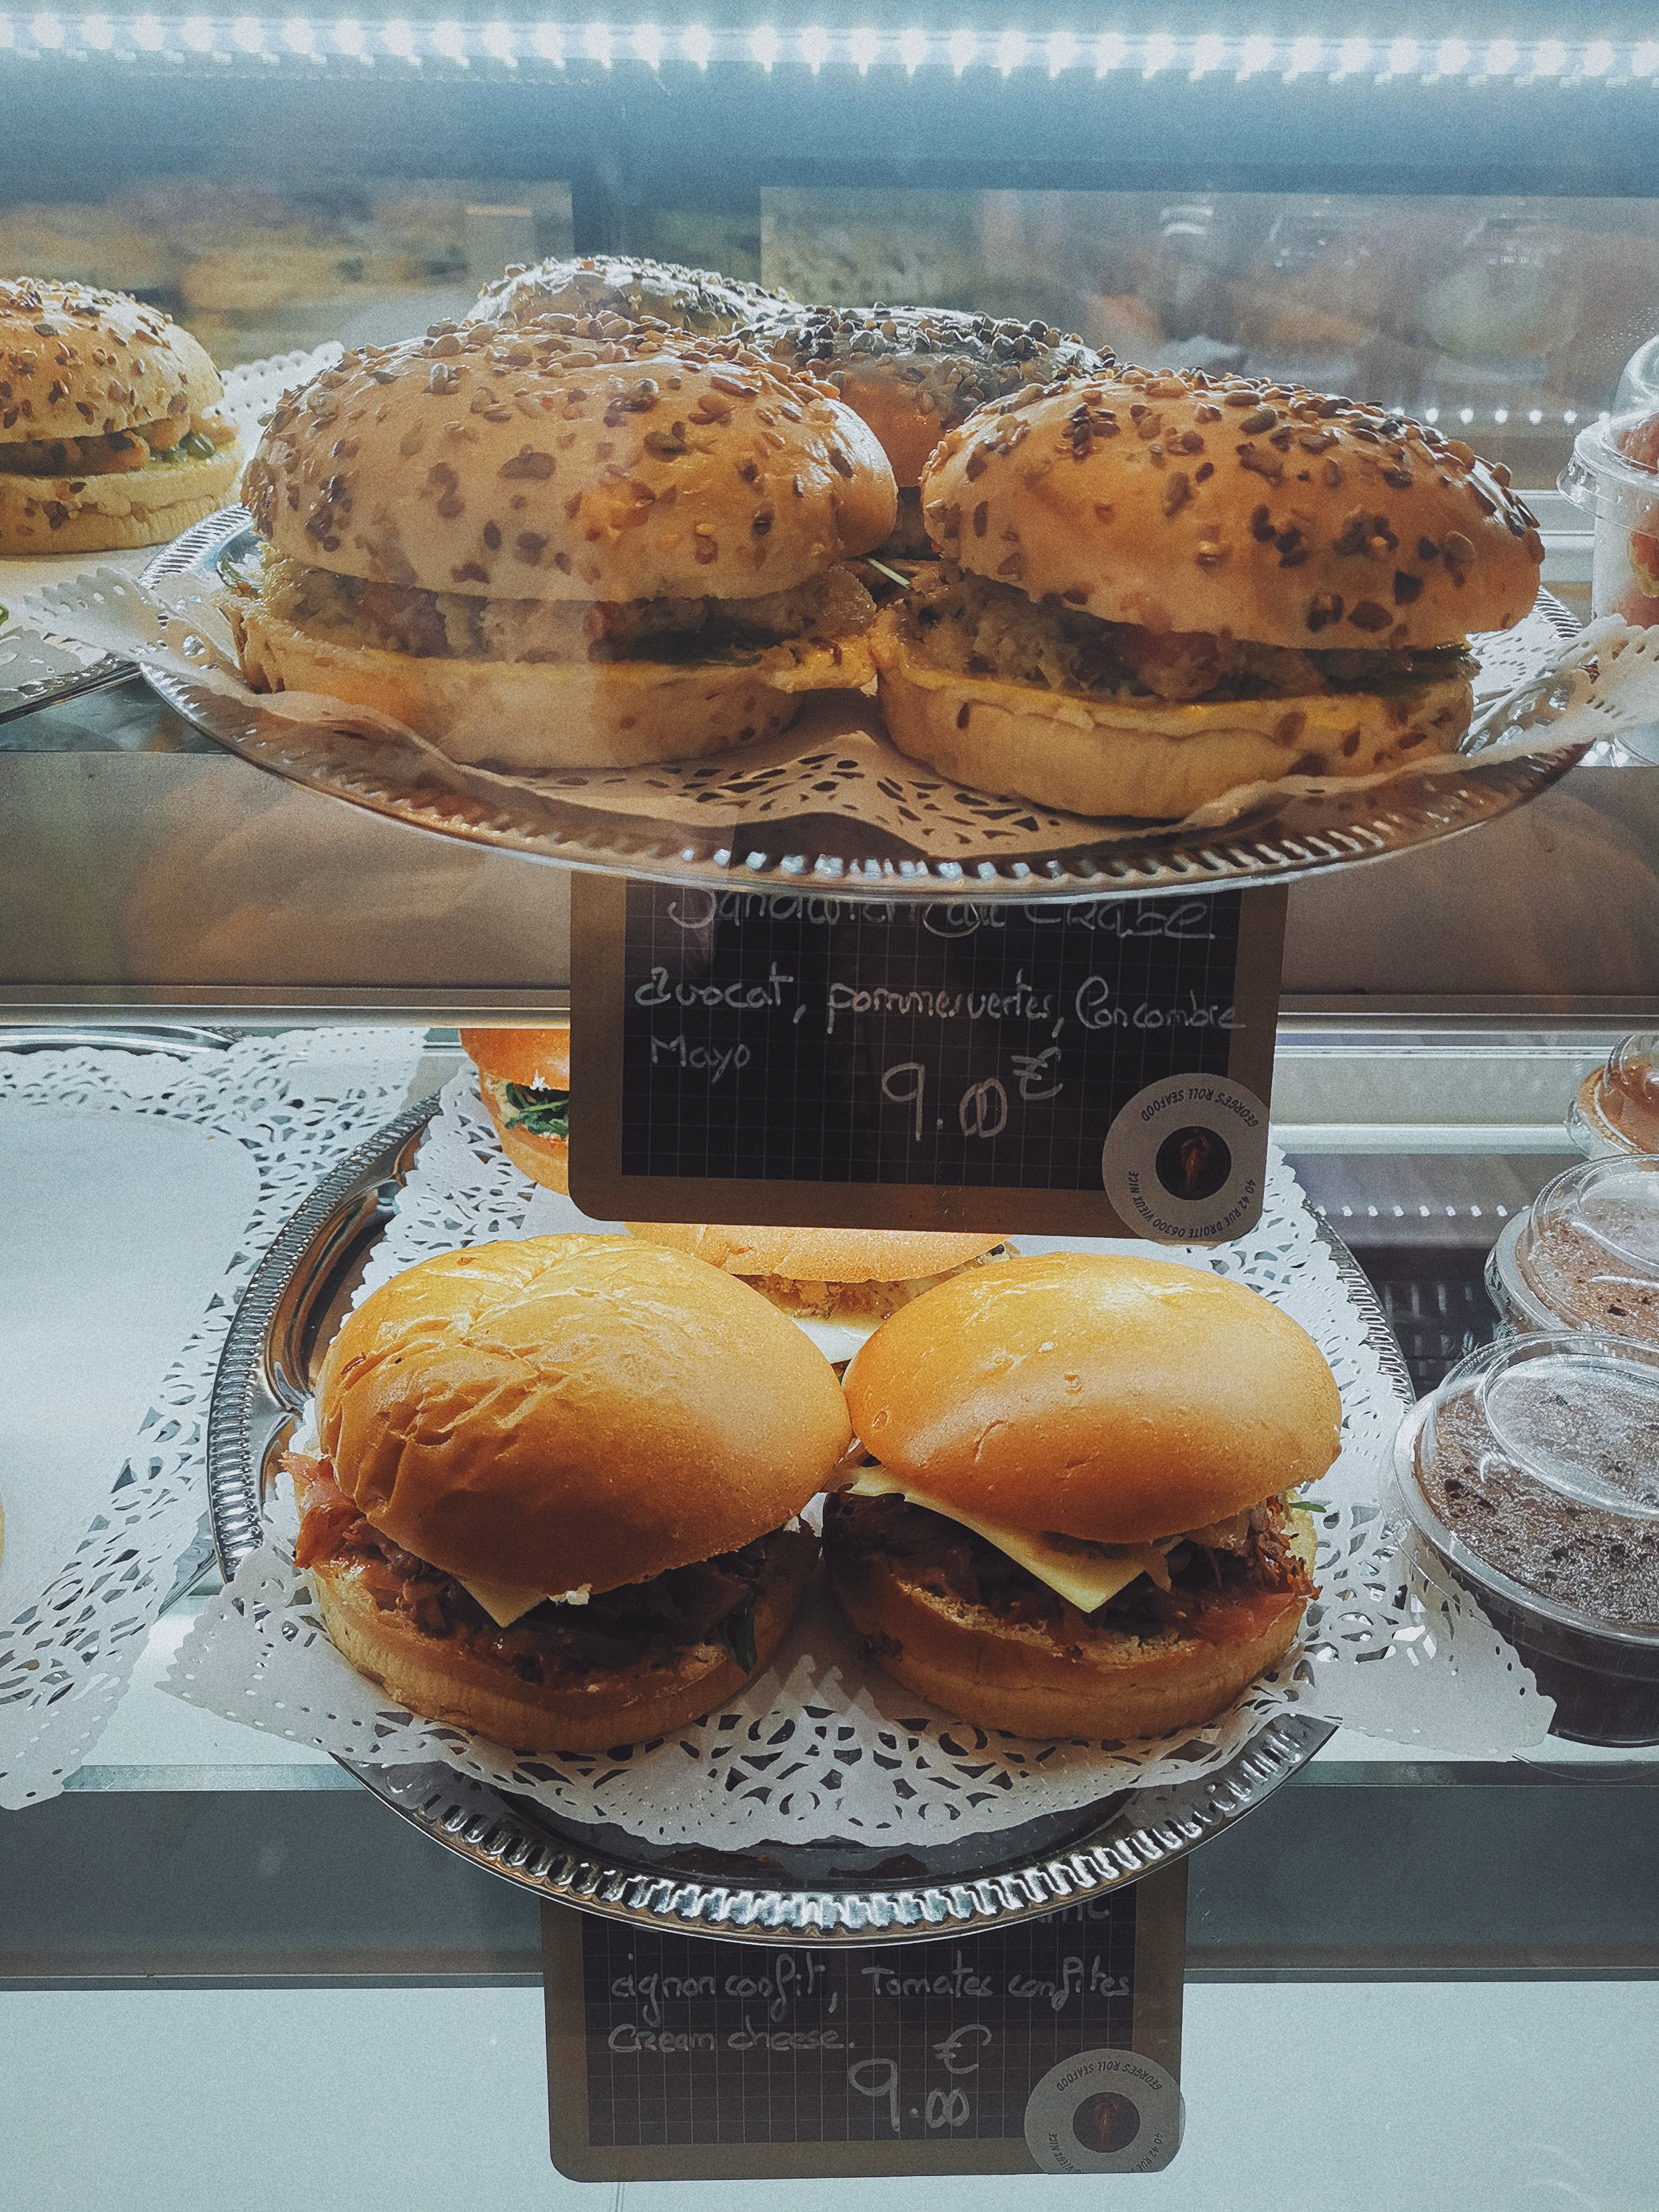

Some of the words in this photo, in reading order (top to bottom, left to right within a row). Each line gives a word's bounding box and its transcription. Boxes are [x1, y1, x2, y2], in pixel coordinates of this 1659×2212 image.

[650, 1033, 752, 1085] Mayo
[1010, 1045, 1064, 1101] €
[1189, 1087, 1215, 1100] ROLL
[1141, 1089, 1185, 1122] SEAFOOD
[1128, 1170, 1141, 1194] NICE
[1245, 1179, 1257, 1194] 40
[1133, 1195, 1155, 1223] VIEUX
[1238, 1195, 1250, 1211] 42
[1152, 1217, 1186, 1238] 06300
[1223, 1207, 1242, 1227] RUE
[1188, 1220, 1224, 1239] DROITE
[861, 1949, 994, 1998] Tomates
[933, 2023, 993, 2075] €
[1056, 2063, 1095, 2091] SEAFOOD
[1097, 2061, 1121, 2072] ROLL
[1048, 2131, 1061, 2153] NICE
[1136, 2156, 1152, 2173] RUE
